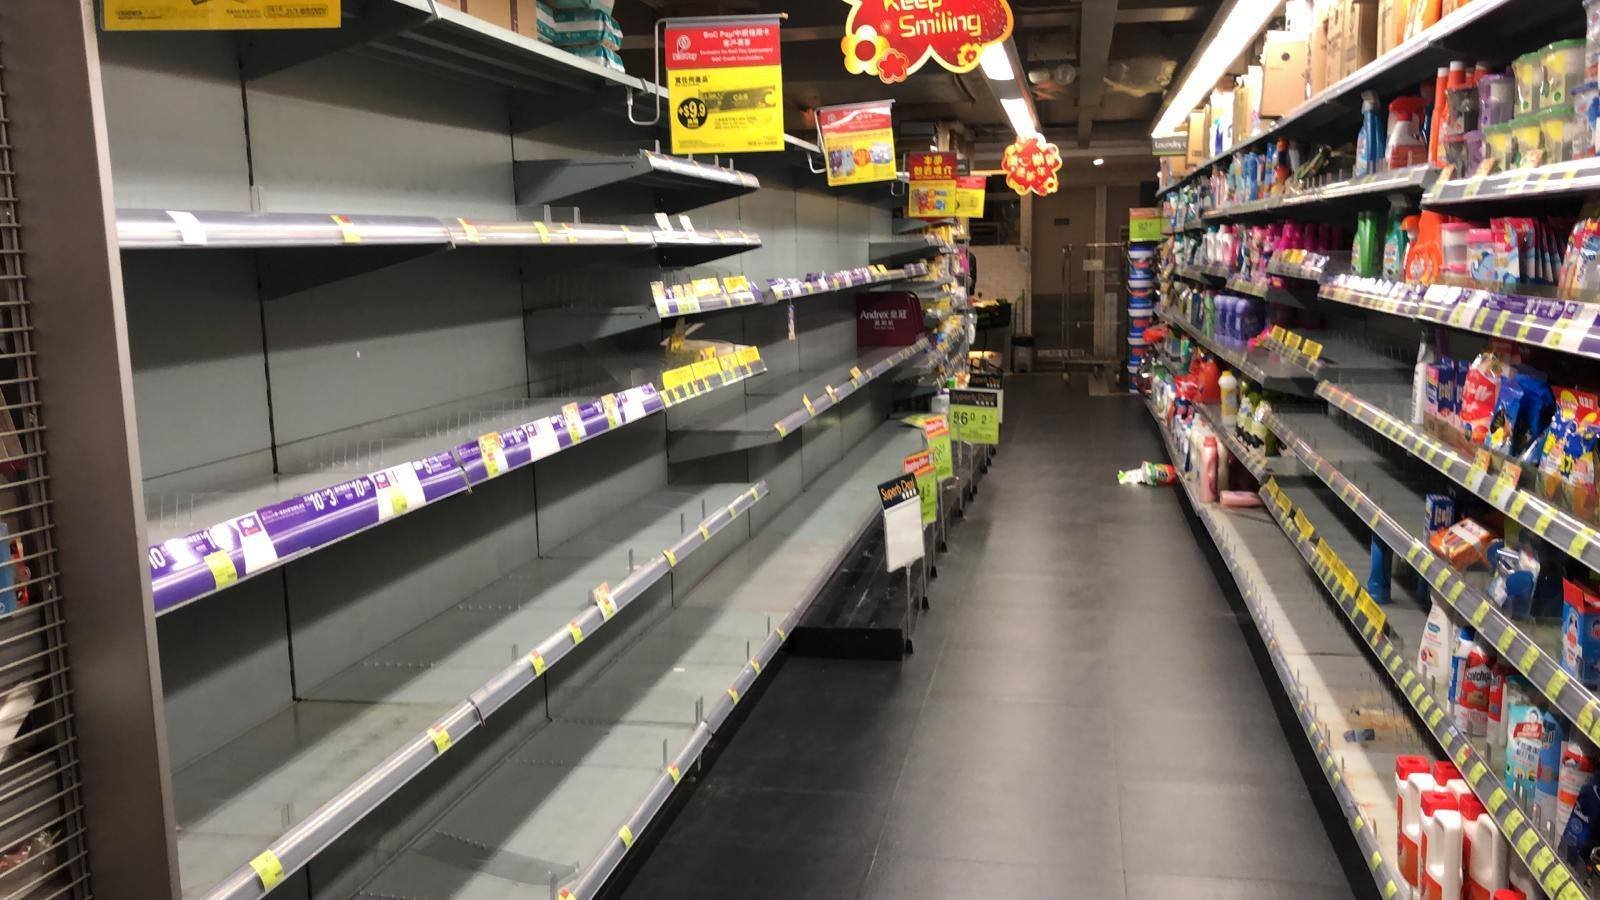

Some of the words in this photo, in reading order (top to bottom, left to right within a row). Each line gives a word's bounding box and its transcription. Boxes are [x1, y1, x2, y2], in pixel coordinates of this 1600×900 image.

[899, 11, 981, 37] Smiling
[860, 309, 889, 320] Andrex
[880, 482, 902, 502] Superb
[900, 475, 915, 492] Deal
